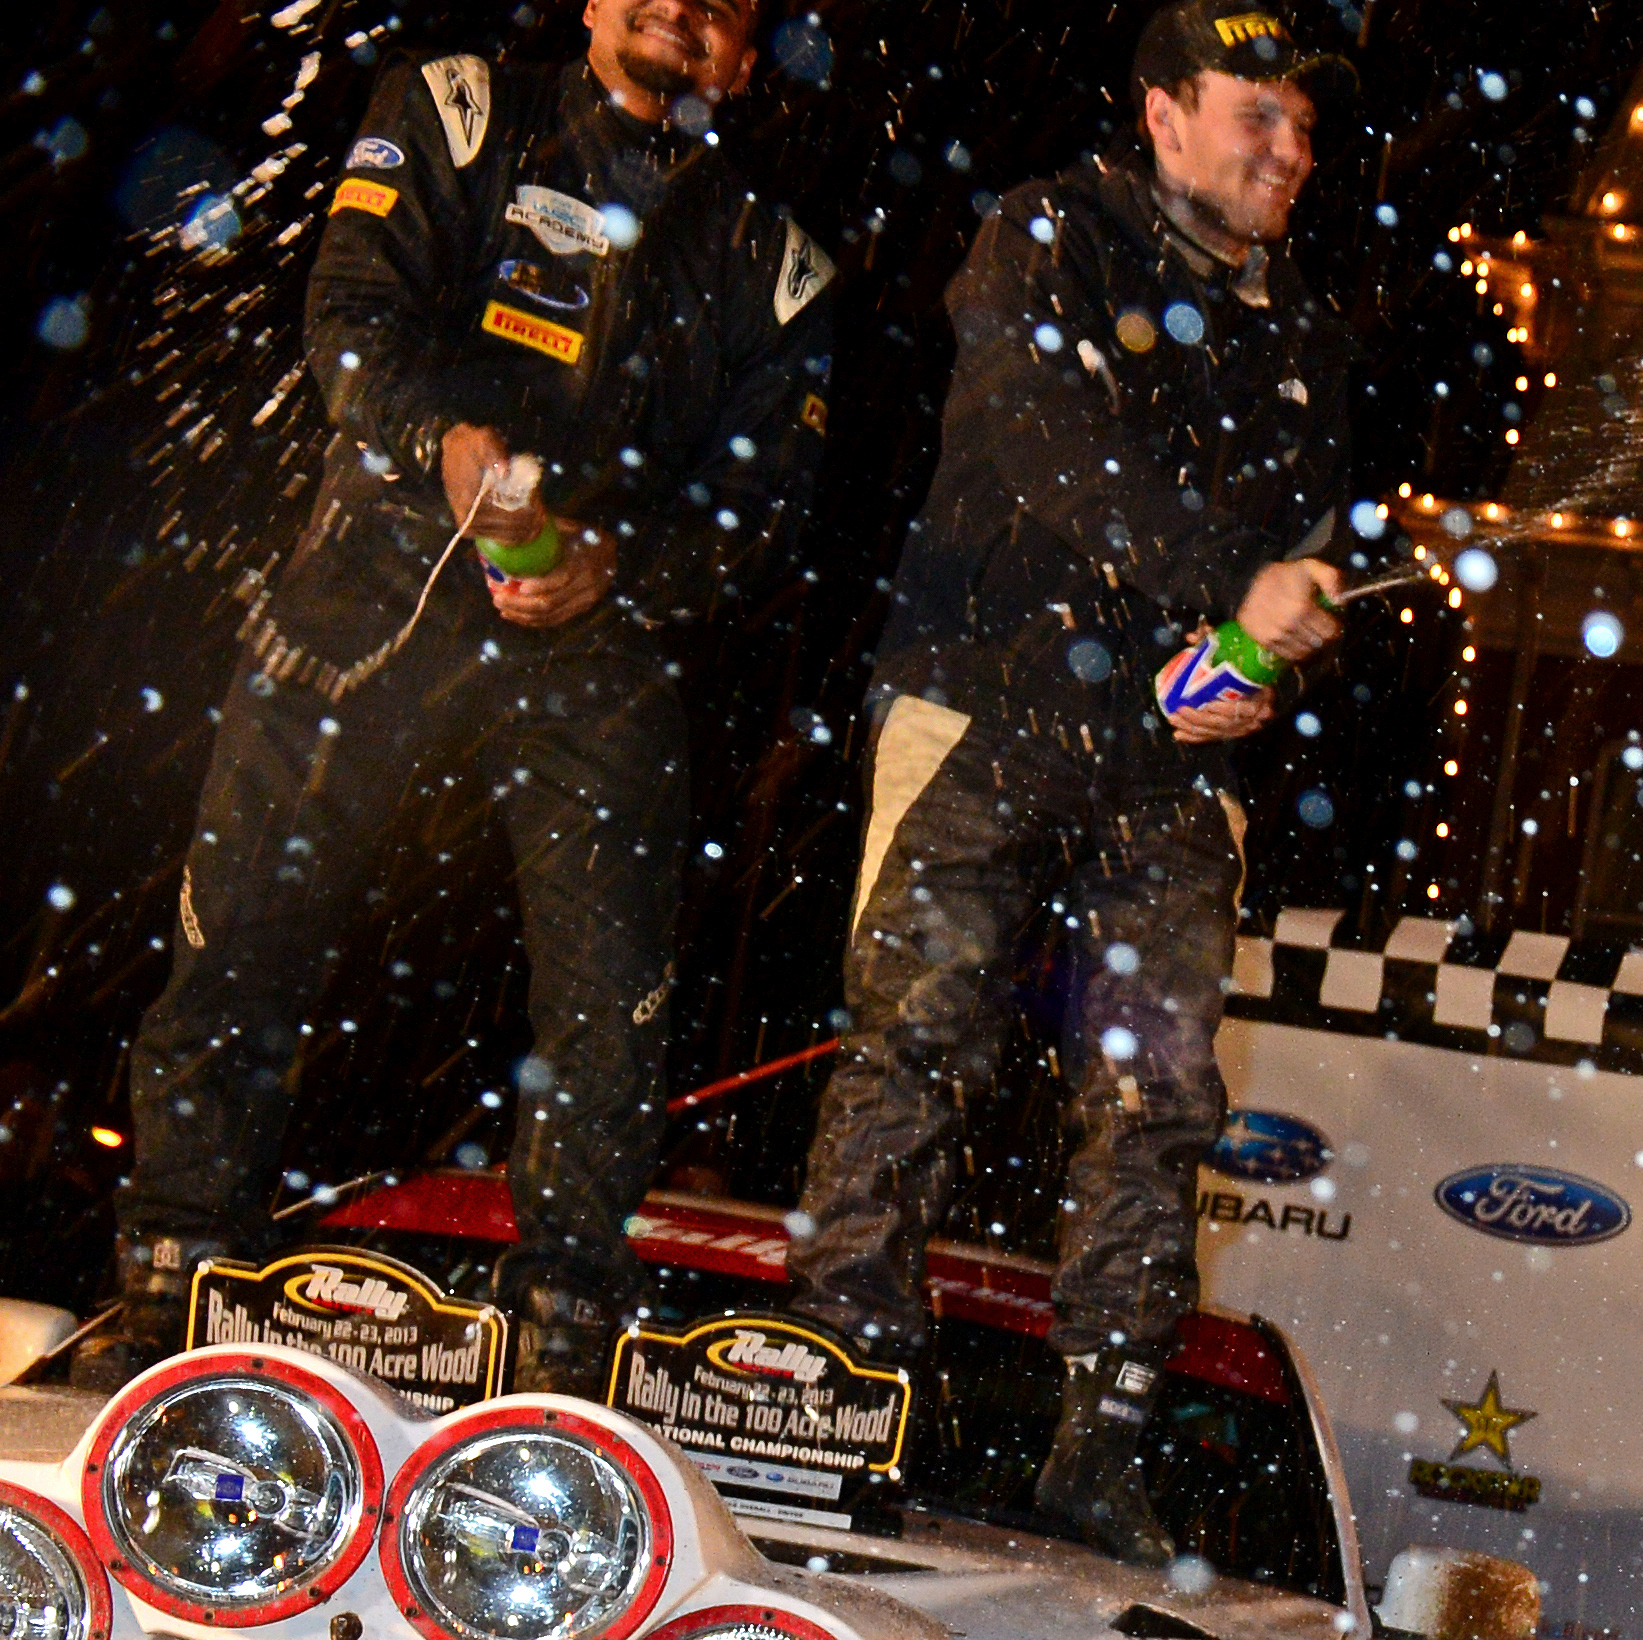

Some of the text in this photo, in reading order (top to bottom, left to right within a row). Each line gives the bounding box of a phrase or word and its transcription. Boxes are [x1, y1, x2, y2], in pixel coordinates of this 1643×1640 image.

[510, 206, 606, 250] ACADEMY
[493, 308, 573, 354] PIRELLI
[1473, 1176, 1594, 1236] Ford
[305, 1263, 409, 1322] Rally
[272, 1302, 332, 1338] February
[384, 1326, 418, 1345] 2013
[328, 1345, 367, 1379] 100
[368, 1346, 418, 1384] Acre
[421, 1326, 483, 1384] Wood
[727, 1329, 827, 1383] Rally
[627, 1351, 896, 1444] Rally in the 100 Acre Wood
[693, 1365, 750, 1396] February
[730, 1435, 866, 1470] CHAMPIONSHIP
